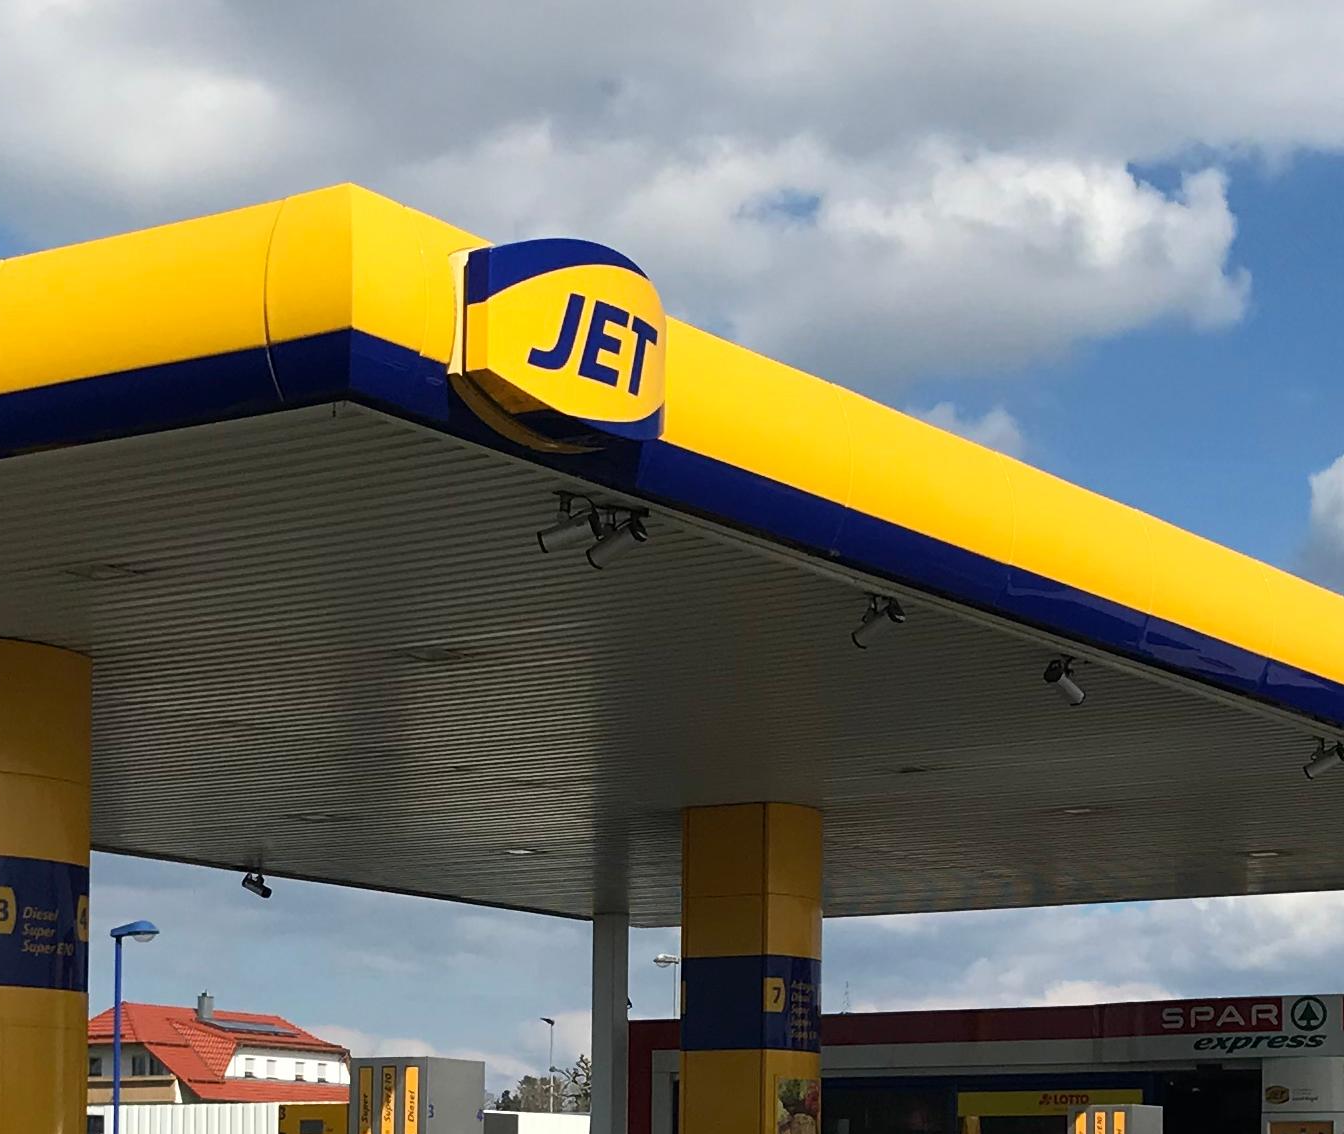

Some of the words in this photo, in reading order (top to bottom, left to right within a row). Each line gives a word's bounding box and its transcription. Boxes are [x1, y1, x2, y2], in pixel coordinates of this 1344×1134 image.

[526, 293, 658, 396] JET
[23, 907, 58, 921] Diesel
[22, 923, 56, 940] Super
[22, 940, 55, 956] Super
[773, 986, 782, 1004] 7
[1161, 1004, 1279, 1029] SPAR
[1193, 1033, 1327, 1054] express
[361, 1093, 369, 1123] Super
[383, 1094, 392, 1122] Super
[407, 1089, 416, 1123] Diesel
[1053, 1094, 1090, 1105] LOTTO
[428, 1104, 434, 1118] 3
[476, 1109, 484, 1122] 4
